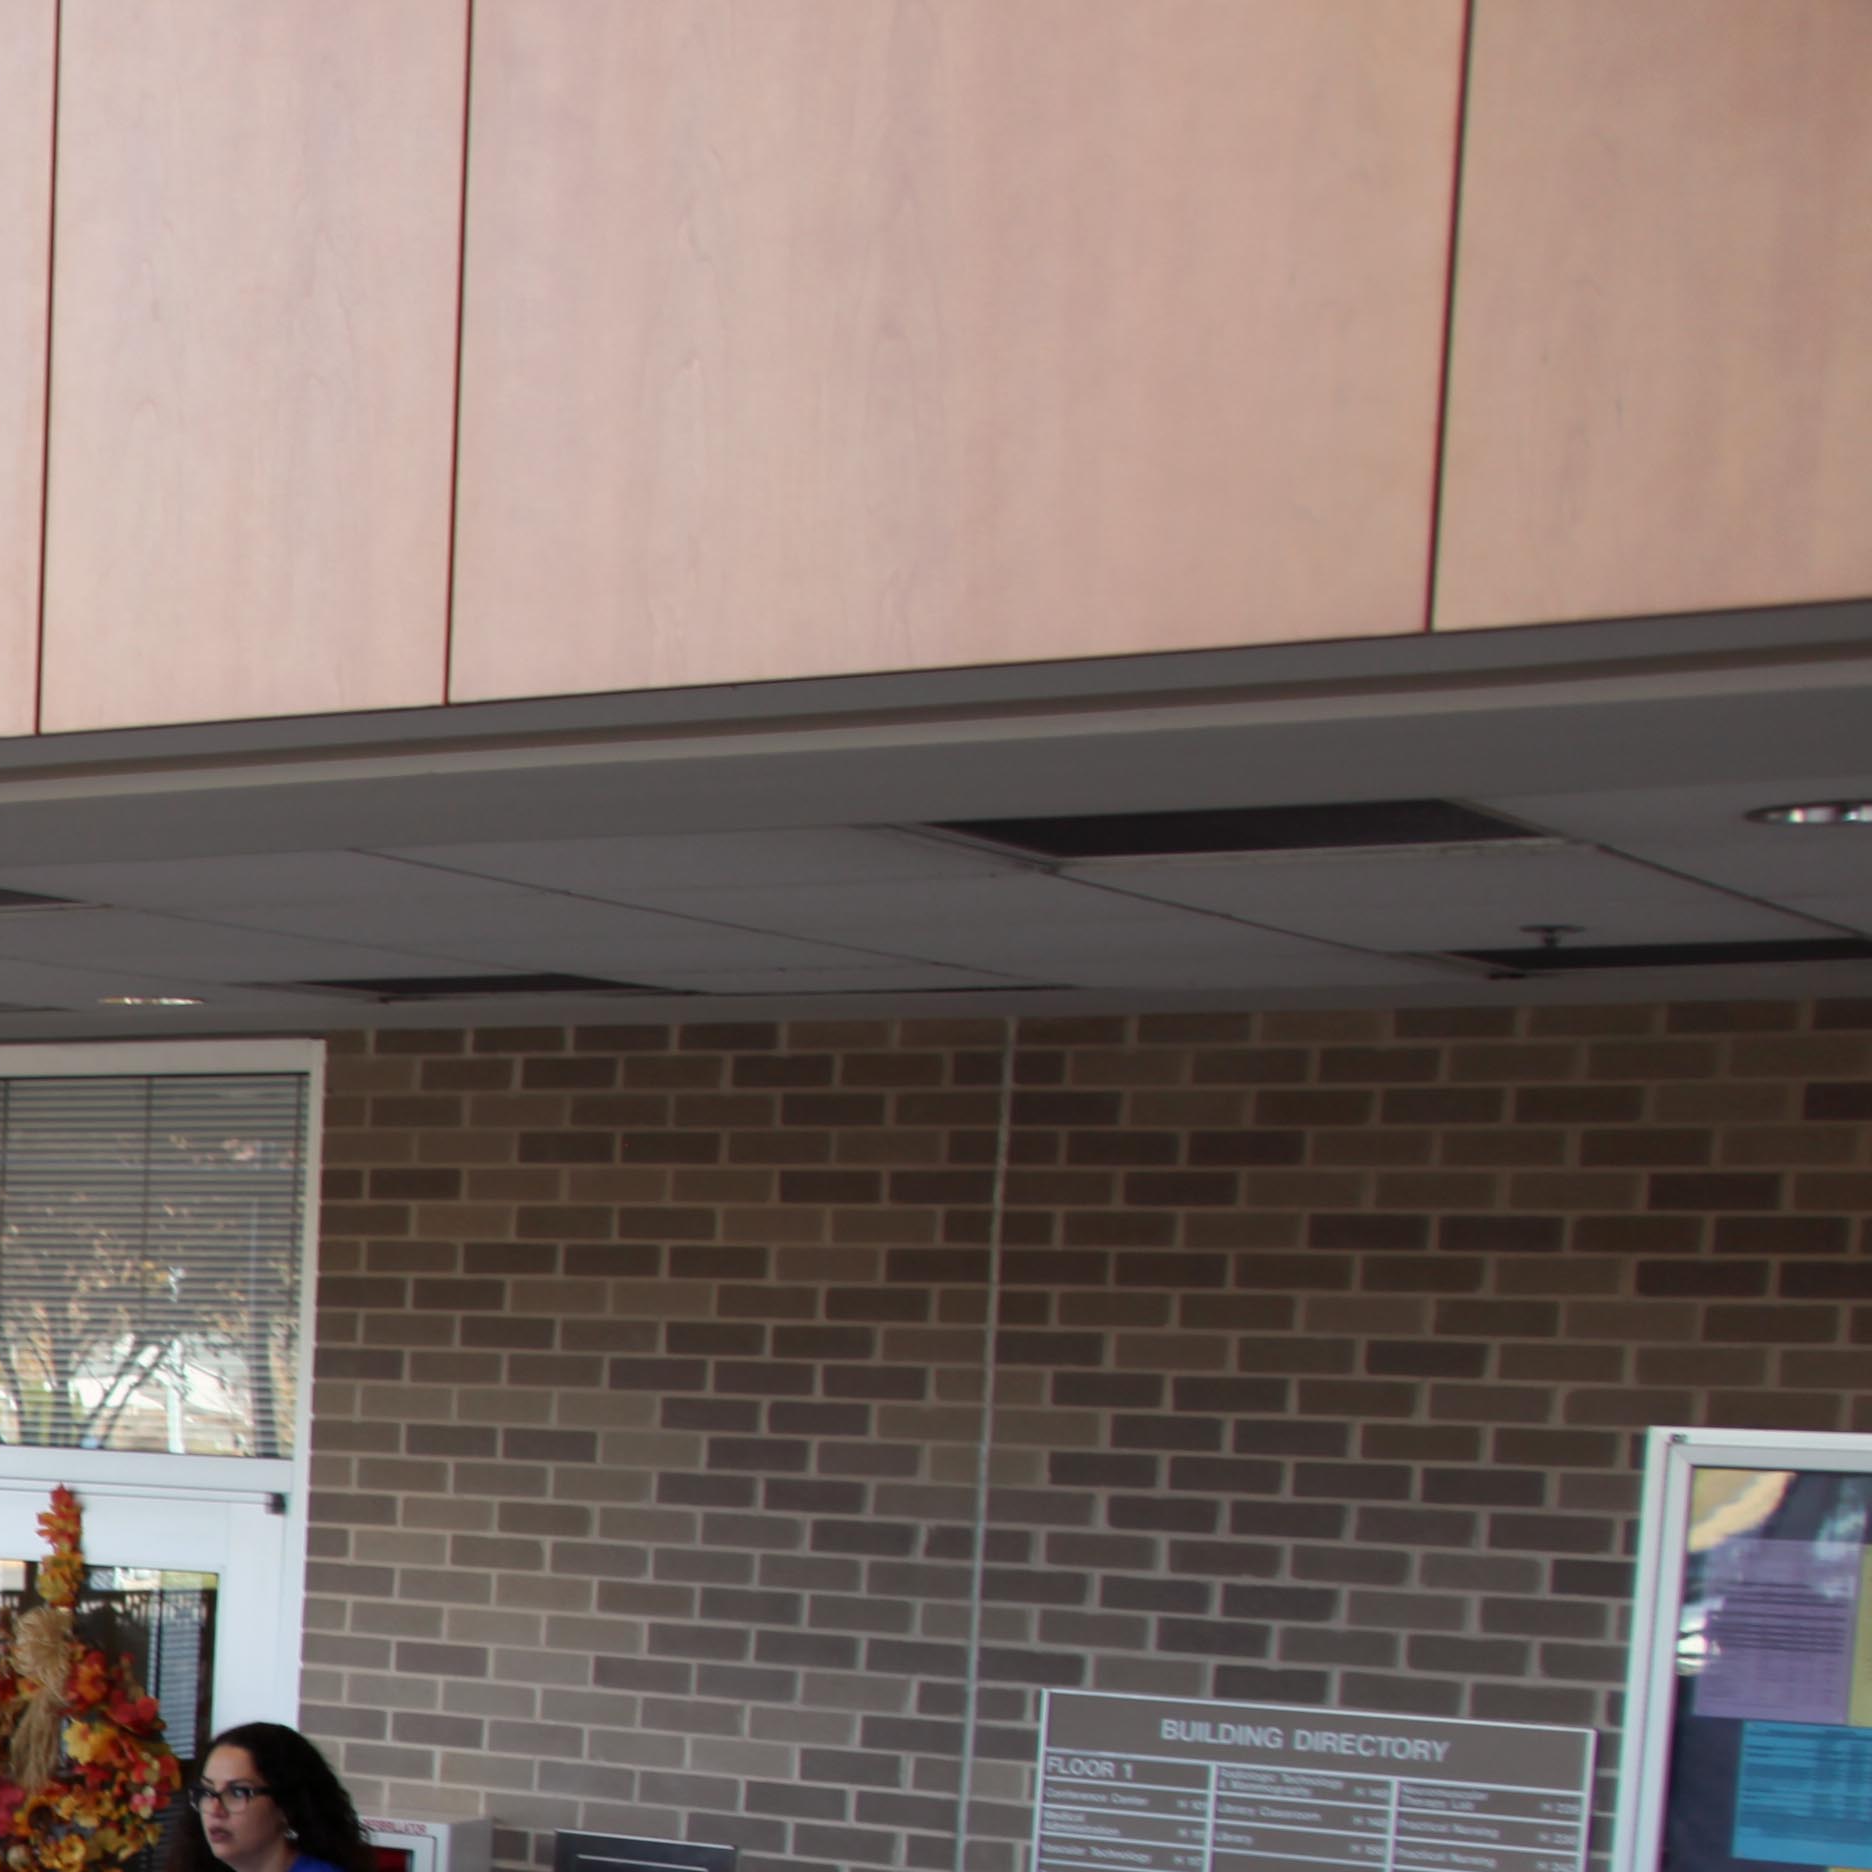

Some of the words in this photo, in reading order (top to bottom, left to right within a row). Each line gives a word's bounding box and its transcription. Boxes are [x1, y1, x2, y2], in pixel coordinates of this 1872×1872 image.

[1160, 1718, 1284, 1749] BUILDING
[1293, 1727, 1451, 1762] DIRECTORY
[1046, 1755, 1115, 1778] FLOOR
[1122, 1762, 1134, 1780] 1
